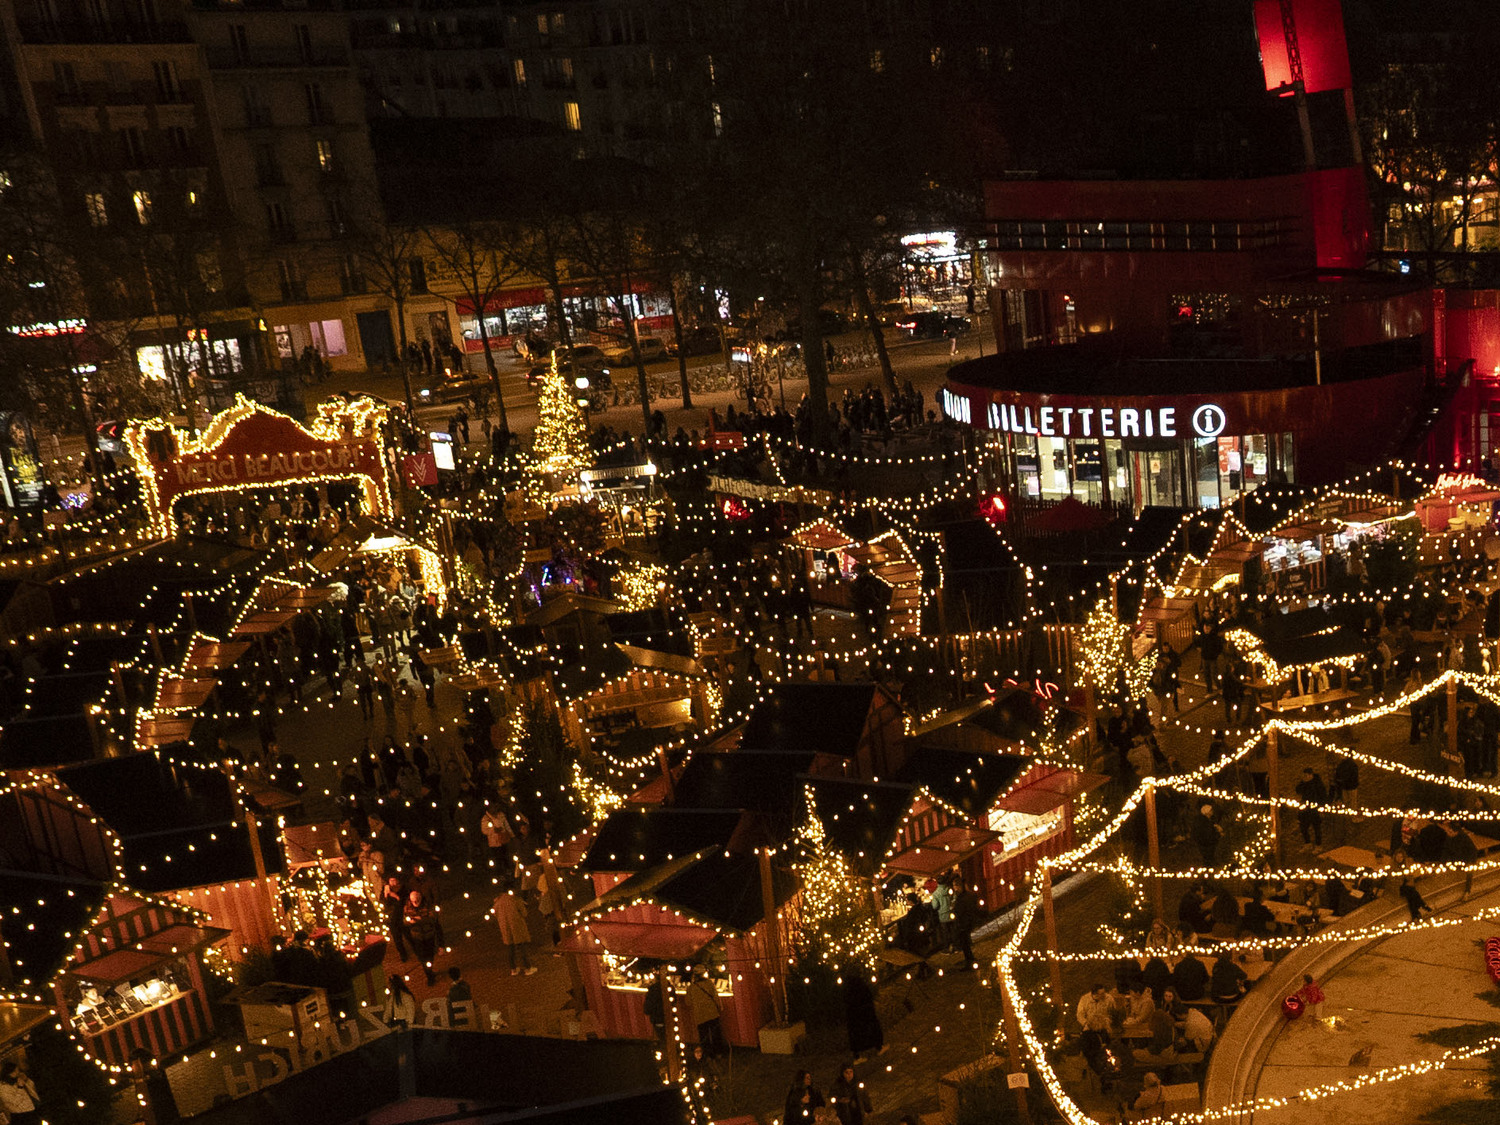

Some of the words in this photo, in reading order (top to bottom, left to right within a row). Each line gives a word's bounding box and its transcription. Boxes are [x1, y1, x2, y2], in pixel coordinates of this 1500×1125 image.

[987, 402, 1176, 437] BILLETTERIE
[176, 459, 237, 485] MERCI
[244, 447, 360, 478] BEAUCOUP!
